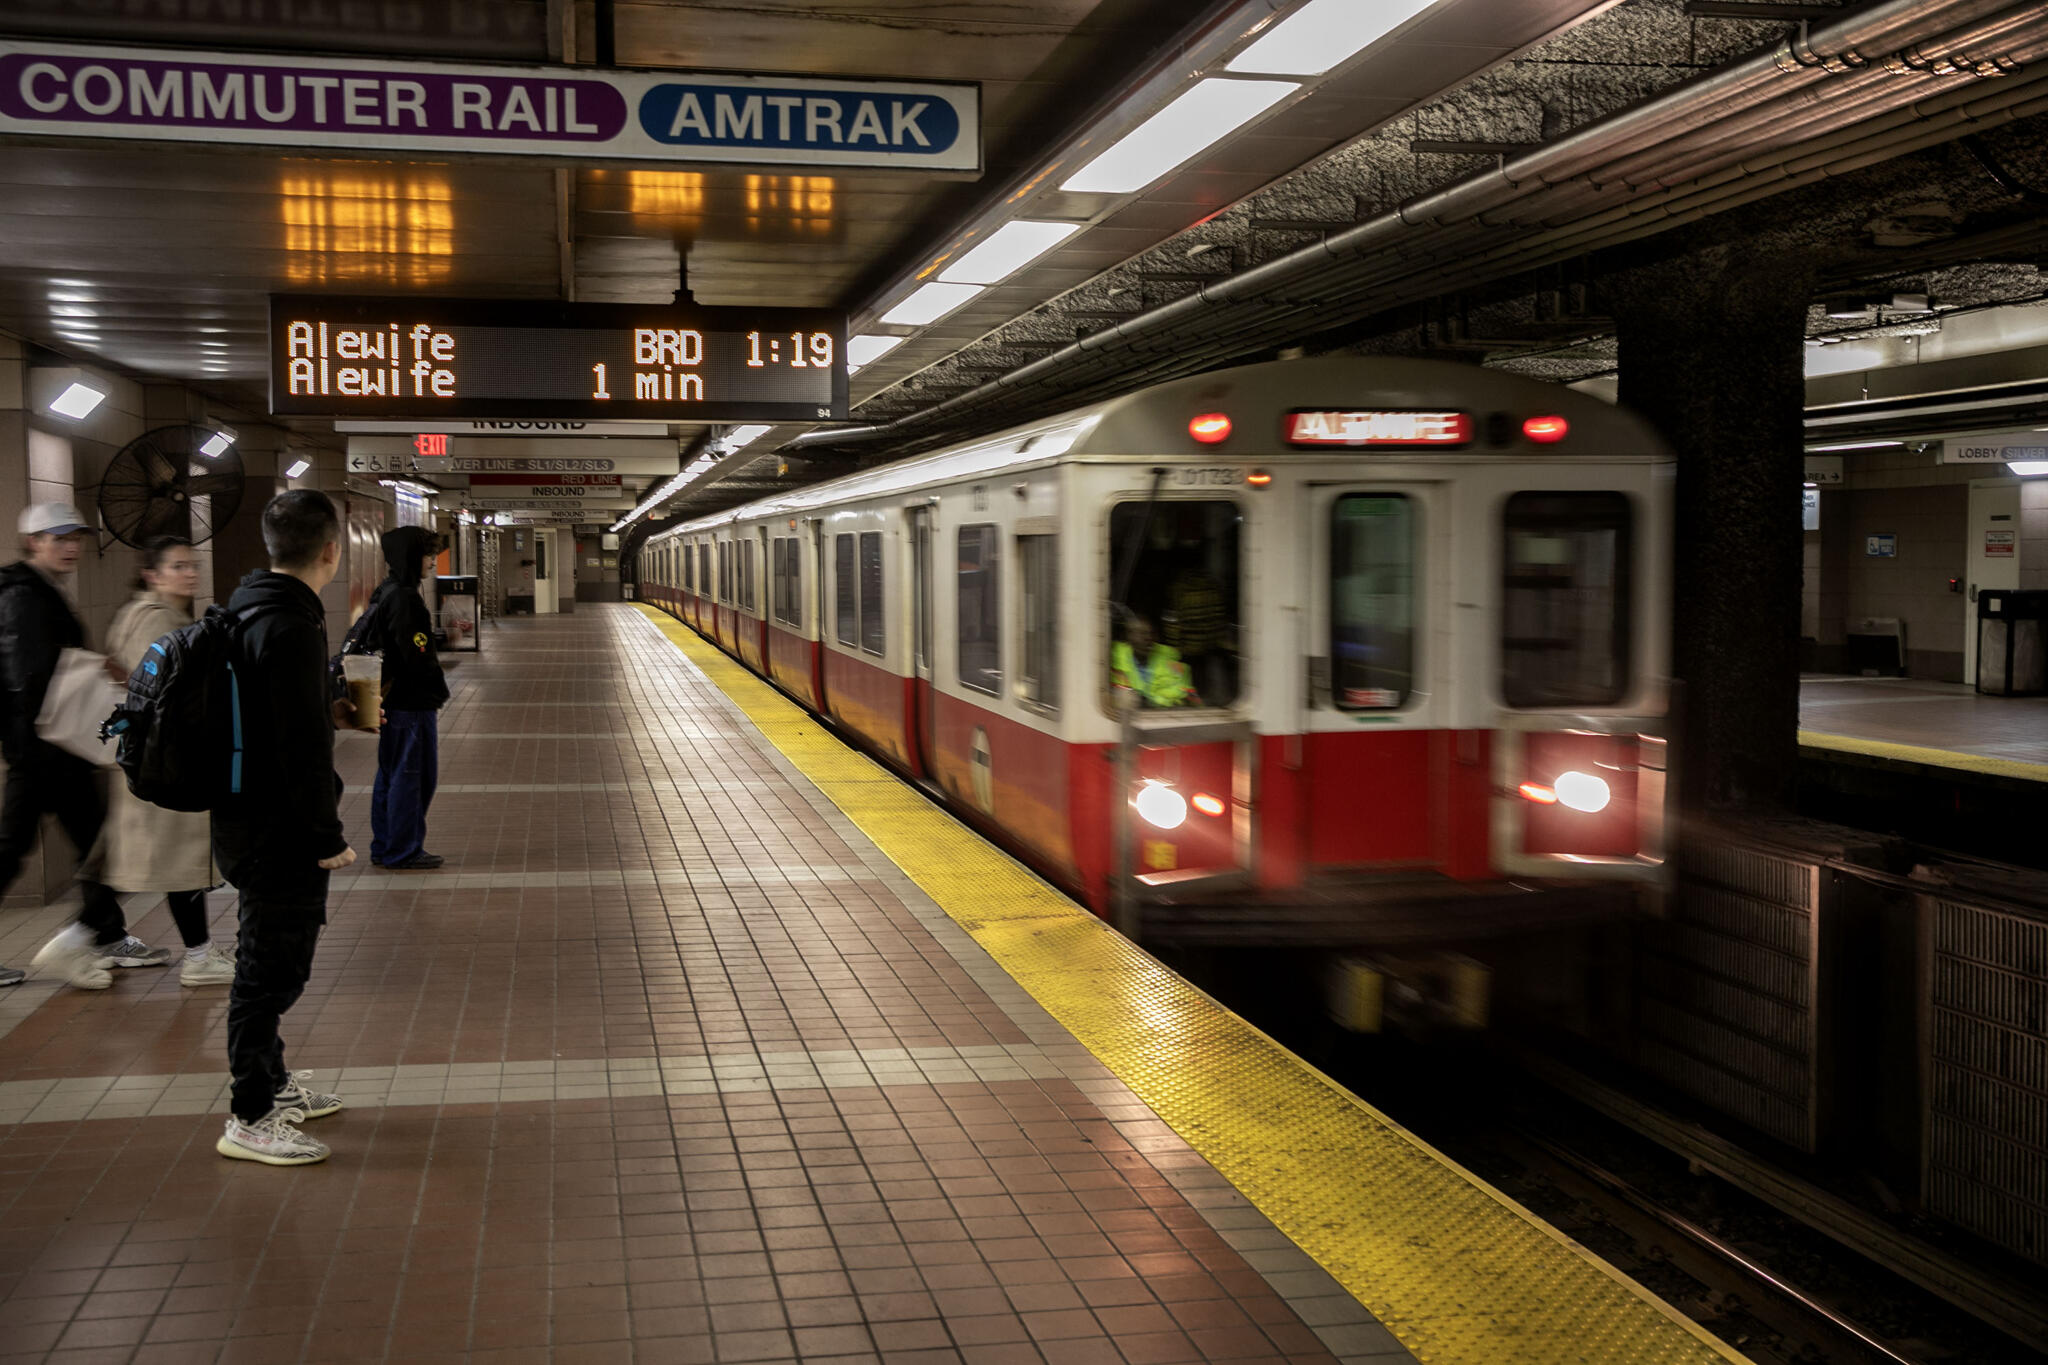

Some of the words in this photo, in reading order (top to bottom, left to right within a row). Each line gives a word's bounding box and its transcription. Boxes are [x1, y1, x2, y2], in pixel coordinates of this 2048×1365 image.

[19, 62, 428, 128] COMMUTER
[452, 82, 599, 135] RAIL
[669, 92, 932, 147] AMTRAK
[289, 320, 456, 361] Alewife
[634, 328, 703, 366] BRD
[747, 330, 833, 368] 1:19
[289, 357, 457, 397] Alewife
[592, 362, 611, 400] 1
[635, 363, 704, 401] min
[817, 408, 832, 418] 94
[418, 433, 448, 455] EXIT
[1958, 447, 1998, 459] LOBBY
[2005, 447, 2046, 459] SILVER
[485, 459, 515, 471] LINE
[528, 460, 610, 472] SL1/SL2/SL3
[561, 474, 586, 485] RED
[591, 474, 618, 485] LINE
[532, 486, 586, 497] INBOUND
